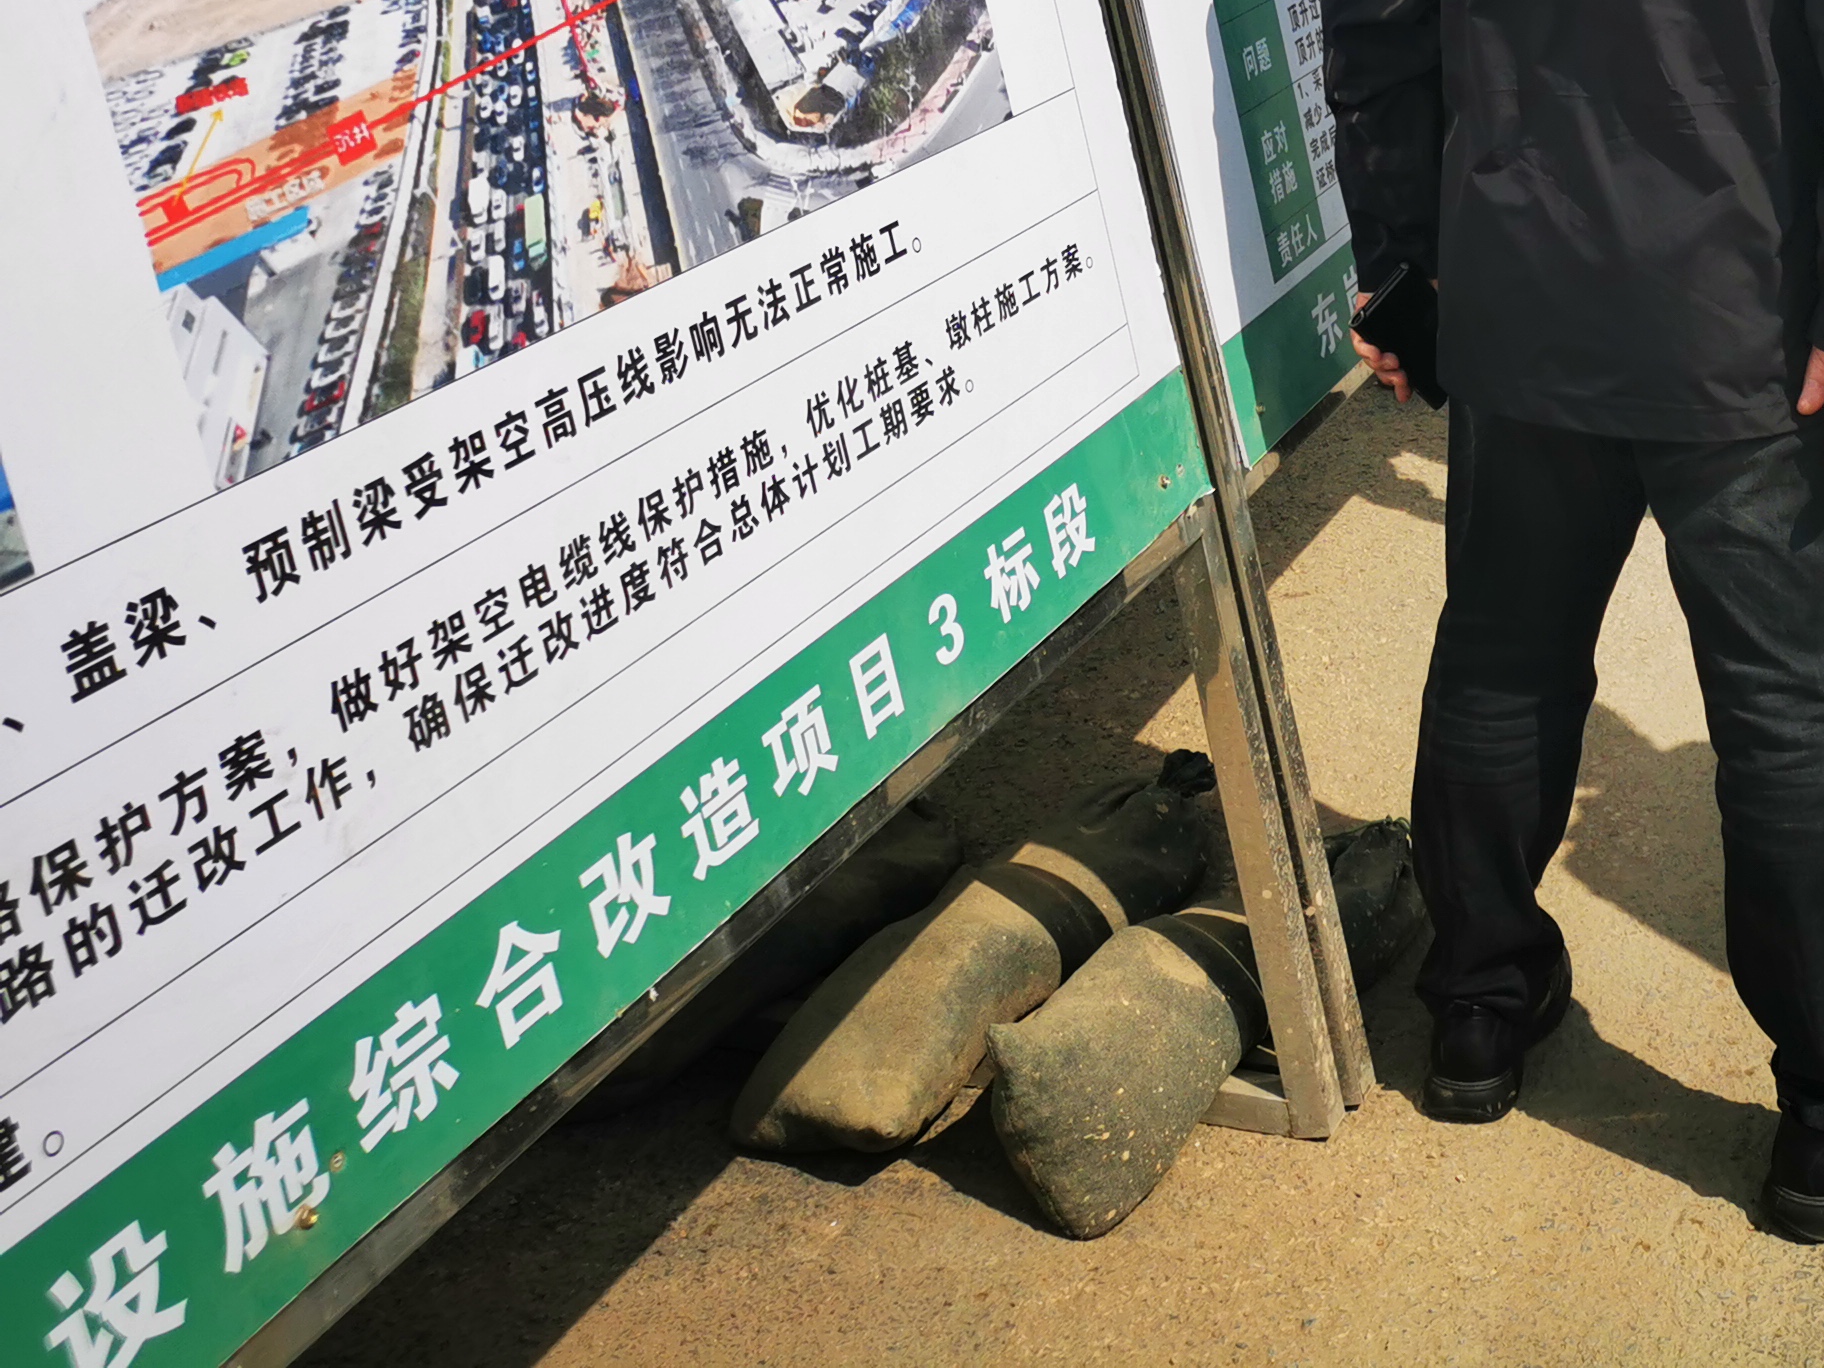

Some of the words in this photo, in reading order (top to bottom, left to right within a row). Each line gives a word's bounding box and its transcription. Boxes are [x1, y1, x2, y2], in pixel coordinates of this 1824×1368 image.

[1242, 36, 1273, 82] 问题
[1260, 120, 1289, 166] 应对
[1268, 160, 1299, 206] 措施
[1276, 212, 1319, 269] 责任人
